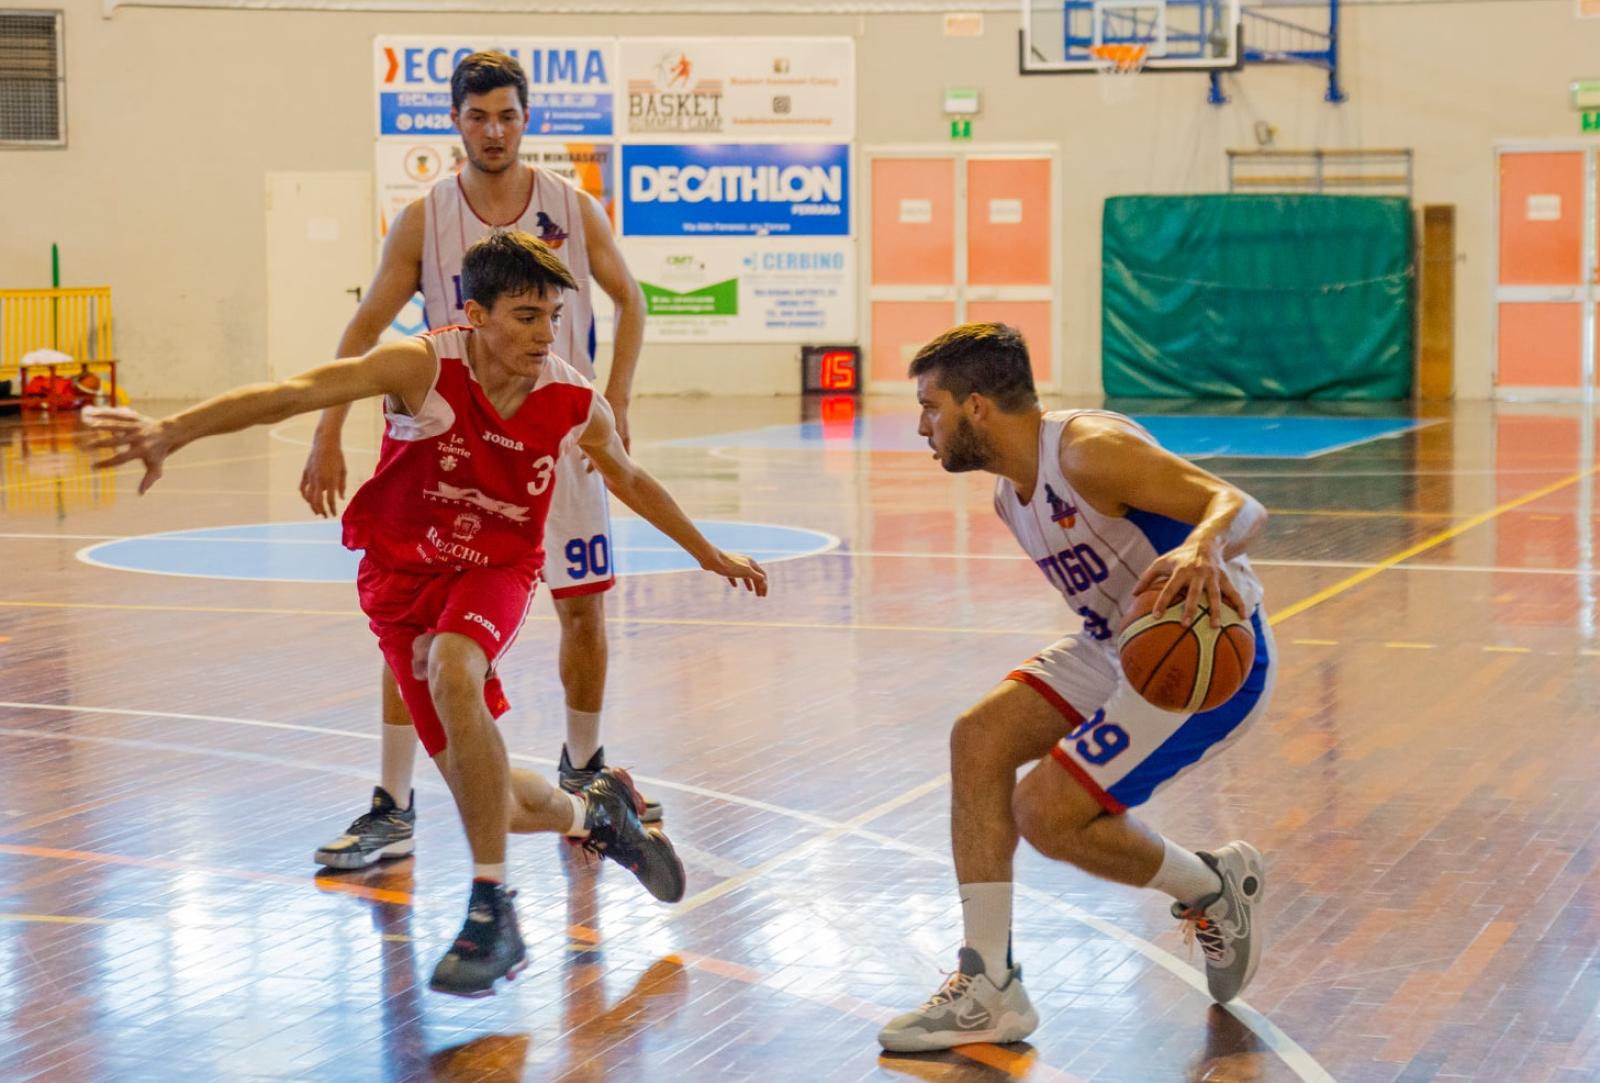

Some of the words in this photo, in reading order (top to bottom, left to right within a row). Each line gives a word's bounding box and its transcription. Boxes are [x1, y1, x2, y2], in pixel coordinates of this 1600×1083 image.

[629, 94, 723, 117] BASKET
[629, 165, 843, 204] DECATHLON
[763, 252, 845, 270] CERBINO
[822, 352, 855, 390] 15
[450, 433, 465, 444] Le
[527, 454, 555, 496] 3
[426, 526, 489, 567] RECCHIA
[565, 534, 609, 580] 90
